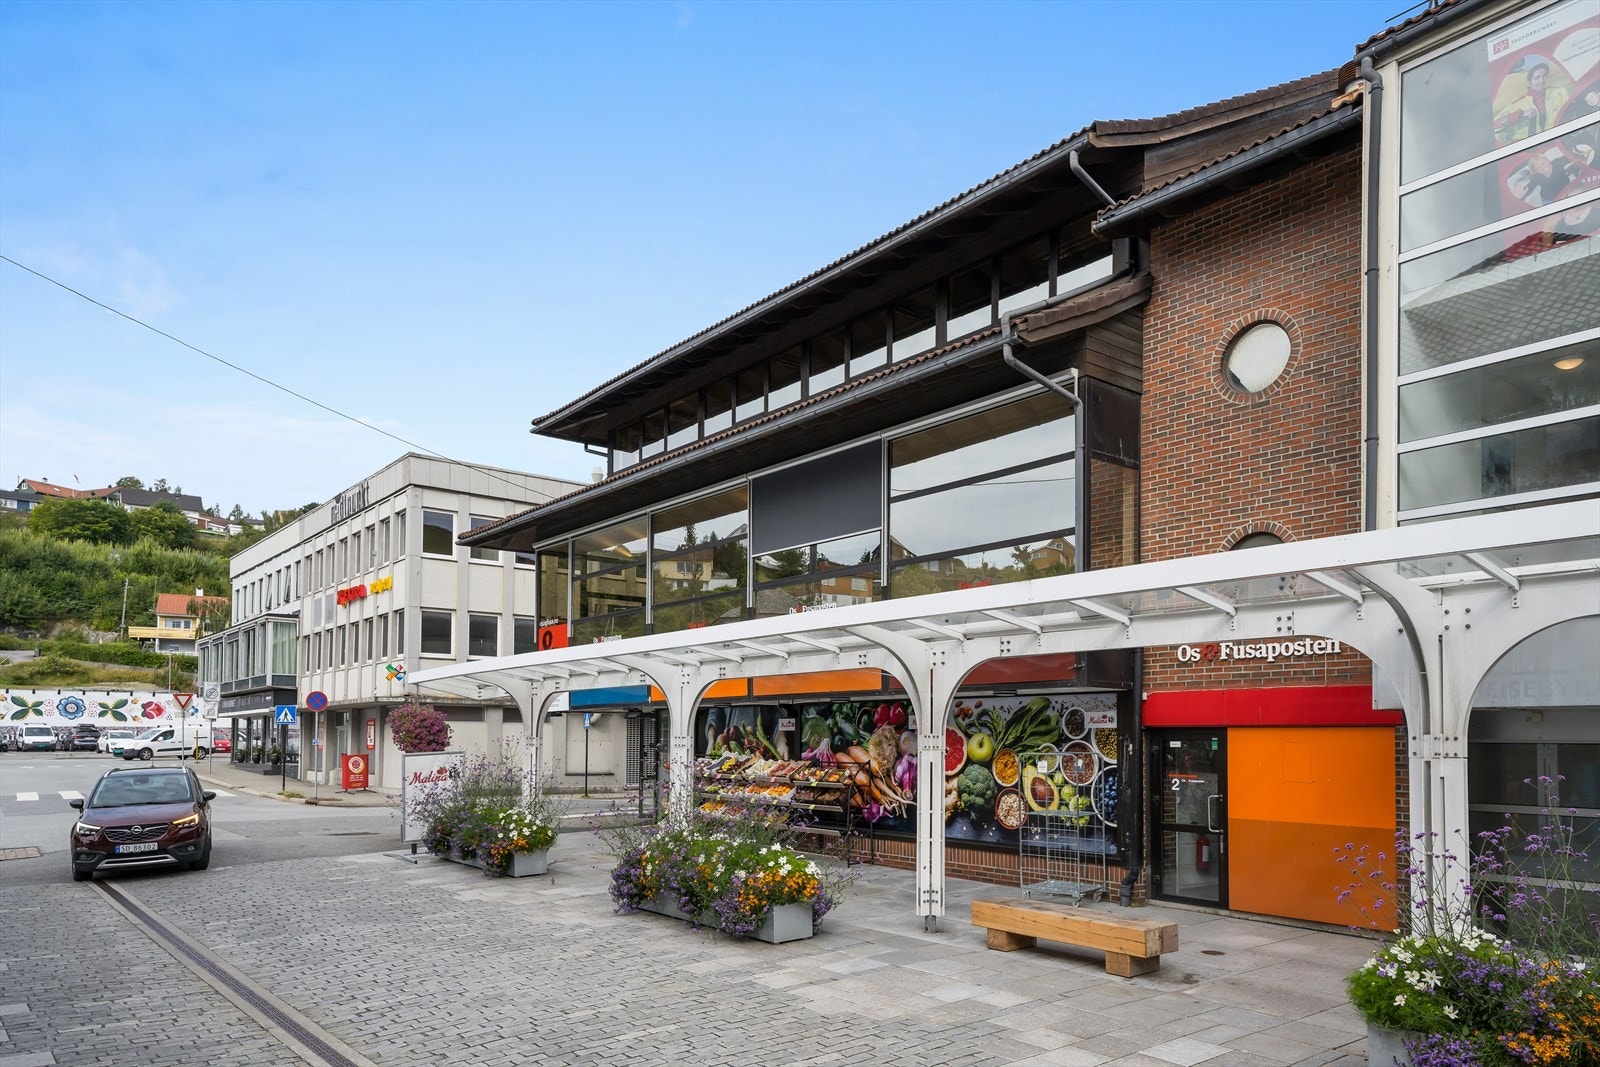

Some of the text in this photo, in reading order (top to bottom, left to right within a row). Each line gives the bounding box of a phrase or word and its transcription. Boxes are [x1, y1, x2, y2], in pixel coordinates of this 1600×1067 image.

[1177, 637, 1341, 662] Os & Fusaposten
[409, 771, 448, 785] Malina
[1171, 778, 1180, 790] 2
[133, 843, 156, 851] 86302
